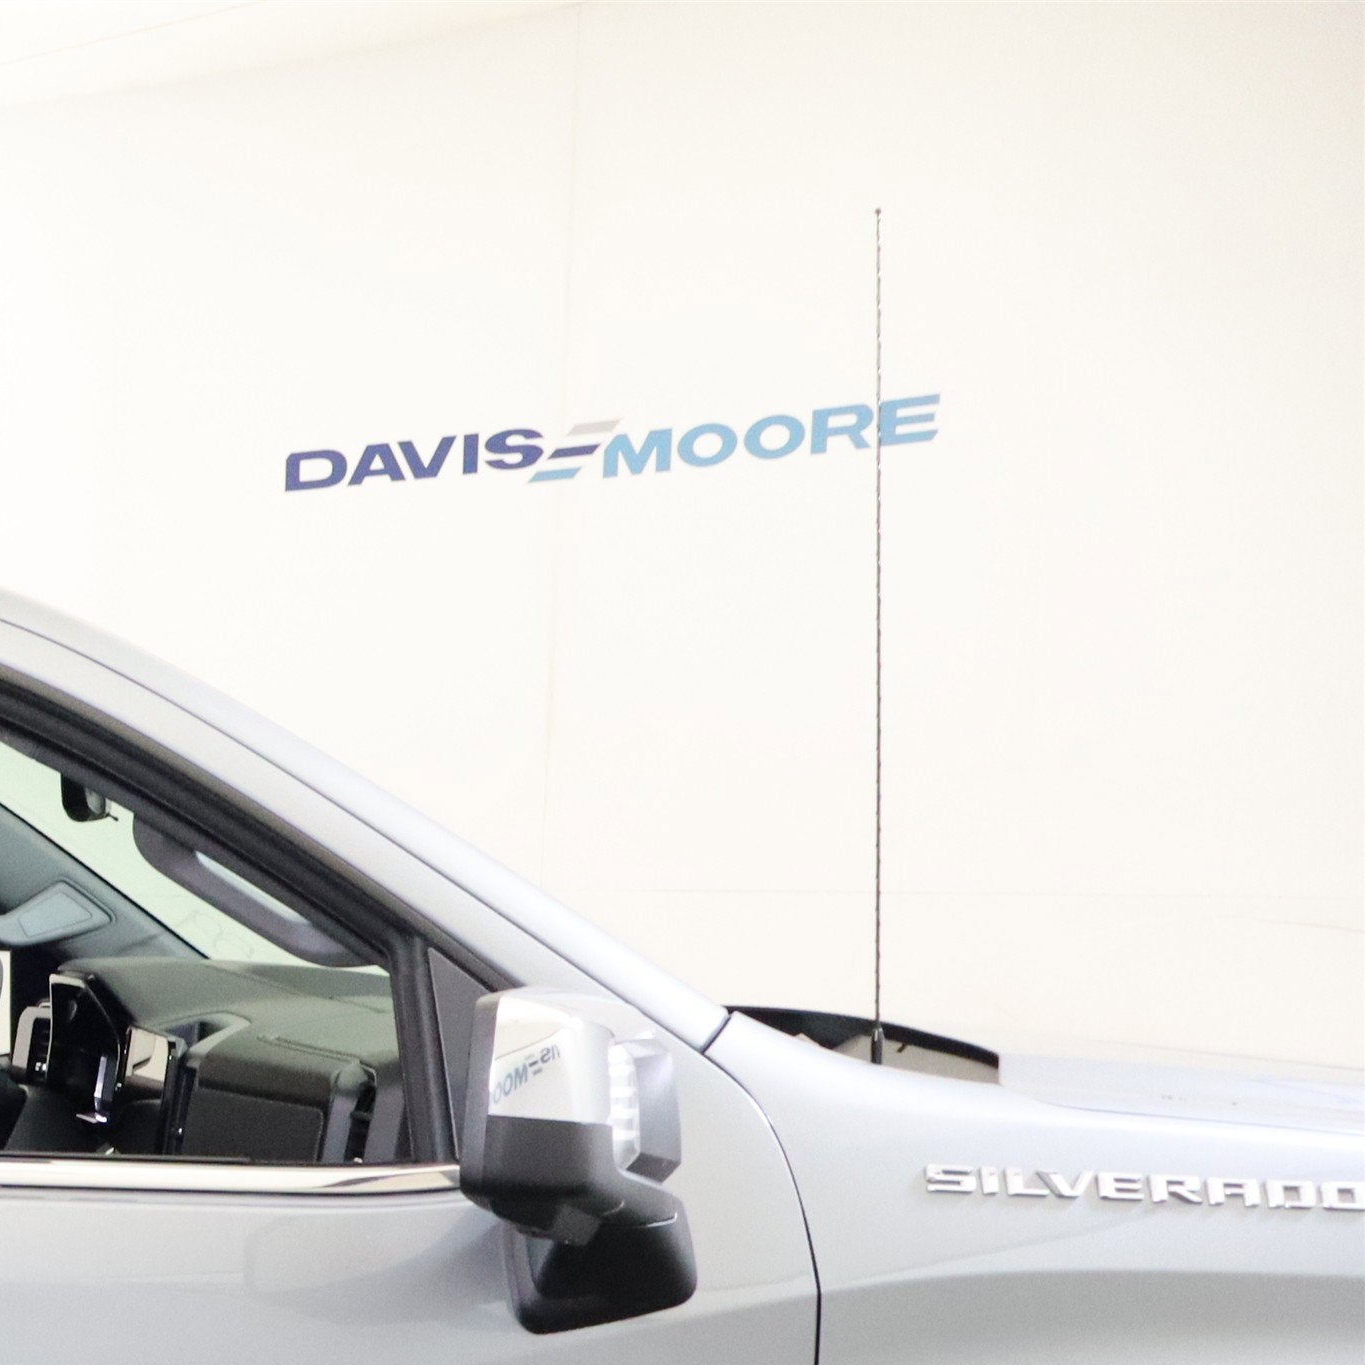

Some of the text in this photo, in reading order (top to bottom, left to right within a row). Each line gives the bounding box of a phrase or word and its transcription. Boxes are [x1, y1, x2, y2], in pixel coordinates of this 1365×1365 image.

[284, 392, 942, 492] DAVIS MOORE
[923, 1163, 1365, 1211] SILVERADO
